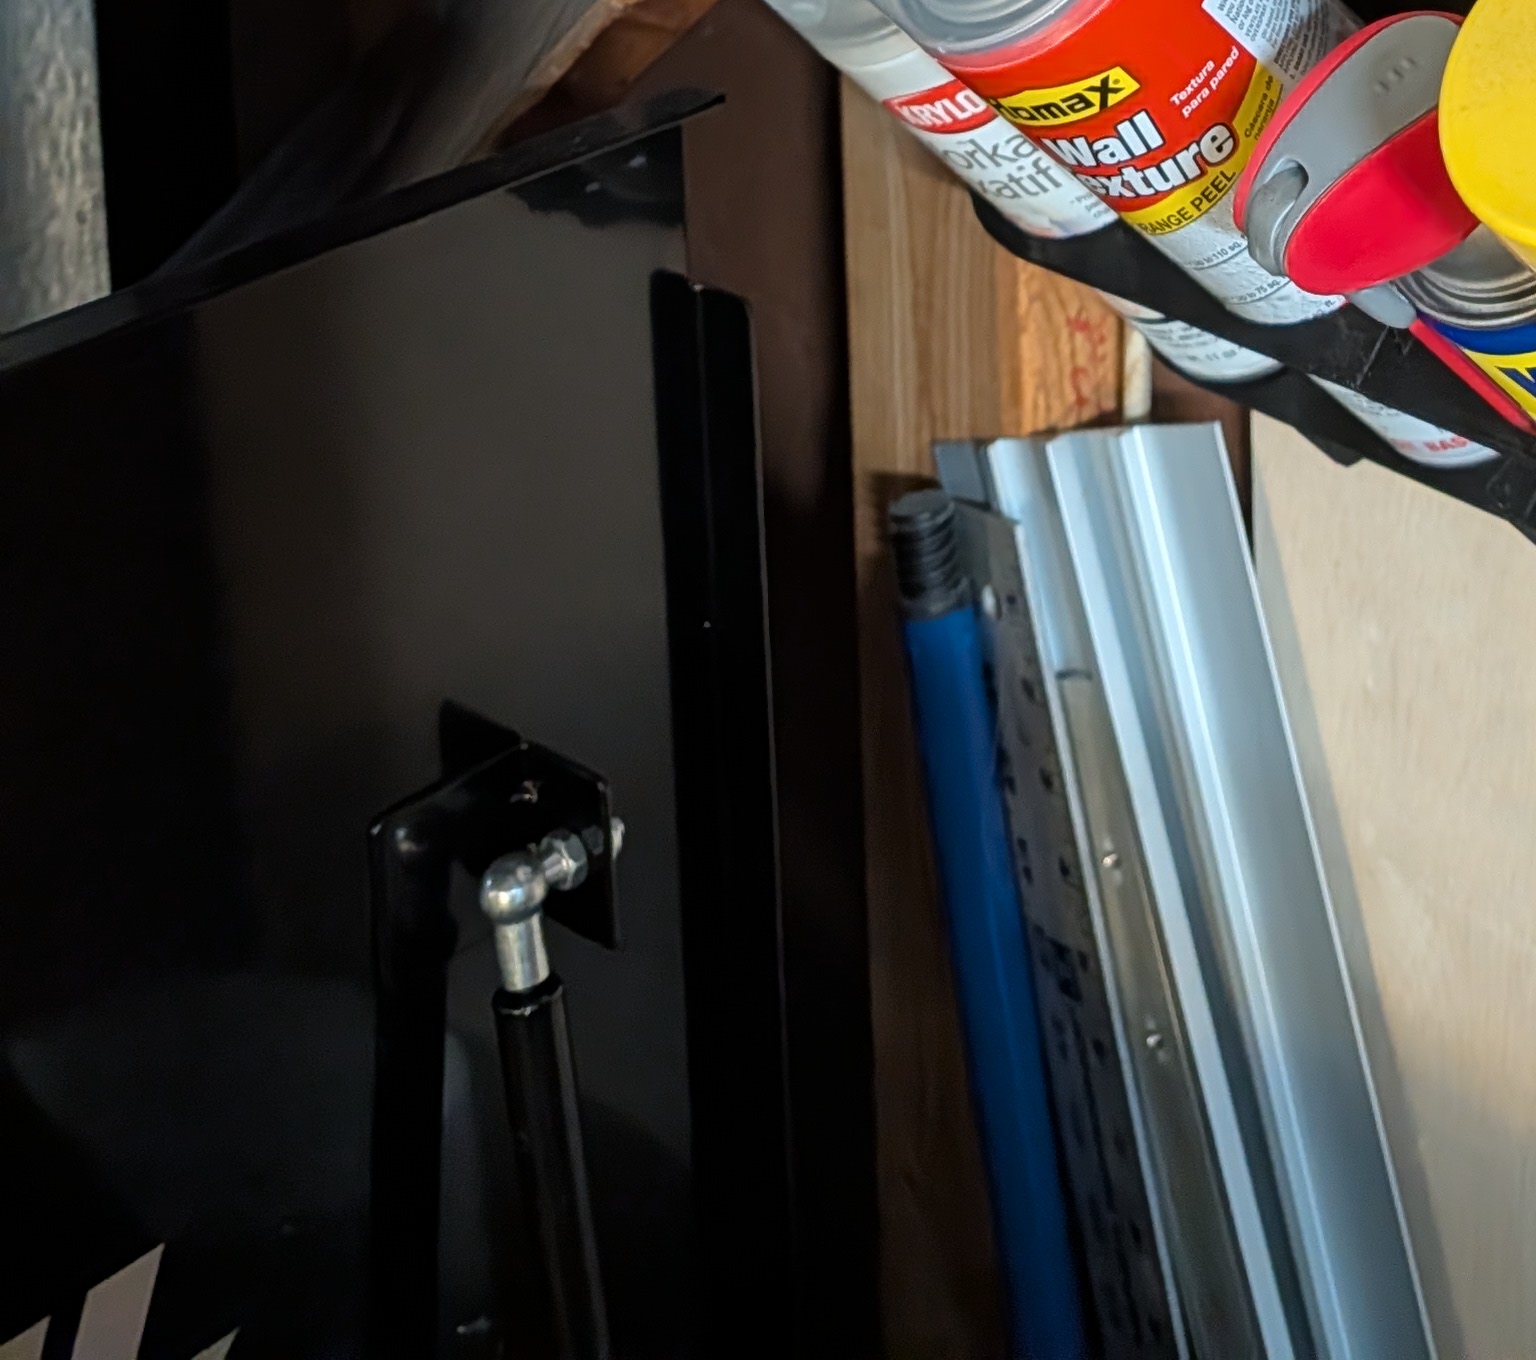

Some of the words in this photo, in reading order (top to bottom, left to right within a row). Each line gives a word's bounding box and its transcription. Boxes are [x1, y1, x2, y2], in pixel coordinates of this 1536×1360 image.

[896, 86, 991, 125] KRYLO
[1168, 58, 1217, 107] Textura
[1178, 84, 1213, 118] para
[1205, 45, 1241, 95] pared
[1039, 108, 1164, 168] Wall
[1189, 164, 1237, 212] PEEL
[1212, 248, 1228, 261] 110
